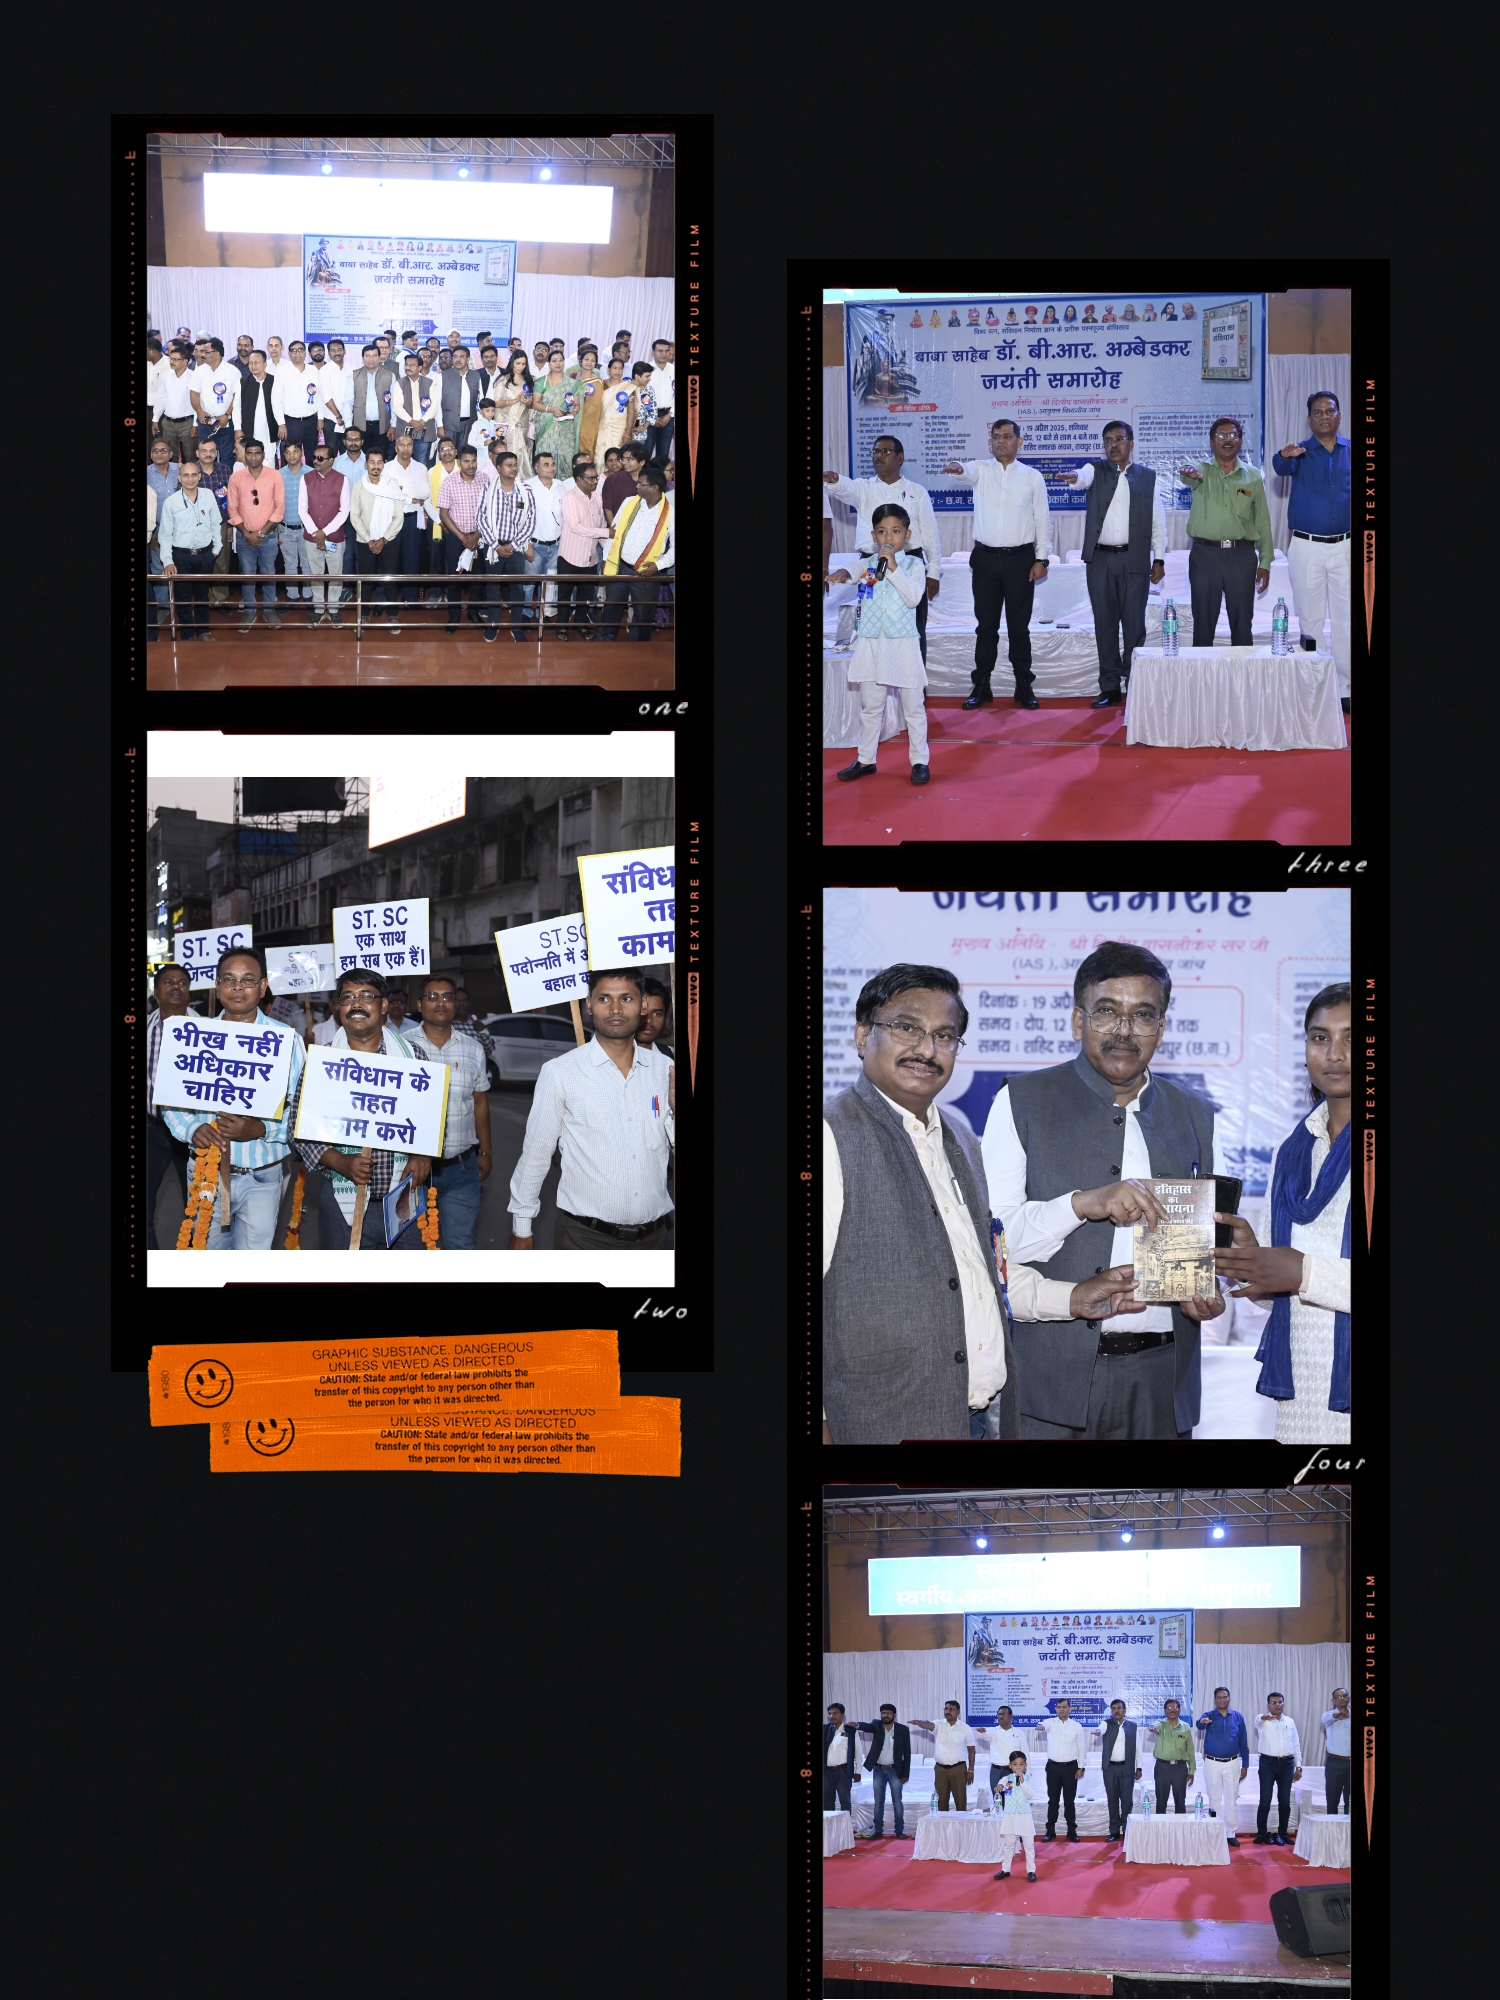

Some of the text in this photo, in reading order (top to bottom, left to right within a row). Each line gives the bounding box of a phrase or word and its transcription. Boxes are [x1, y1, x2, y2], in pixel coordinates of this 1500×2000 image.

[437, 260, 480, 272] अम्बेडकर
[374, 272, 445, 287] जयंती समारोह
[915, 336, 1192, 364] बाबा साहेब डॉ. बी.आर. अम्बेडकर
[981, 366, 1123, 390] जयंती समारोह
[945, 496, 965, 505] छ.ग.
[639, 701, 688, 715] one
[1288, 852, 1367, 873] three
[602, 861, 675, 895] संविध
[352, 906, 408, 930] ST. SC
[182, 932, 244, 959] ST. SC
[355, 930, 406, 951] एक साथ
[340, 955, 356, 972] हम
[362, 953, 380, 968] सब
[385, 952, 405, 970] एक
[510, 951, 562, 977] पदोन्नति
[564, 947, 576, 964] में
[543, 974, 577, 992] बहाल
[979, 990, 1046, 1009] दिनांक 19
[978, 1017, 1011, 1031] समय
[1054, 1019, 1066, 1032] 12
[1176, 1018, 1199, 1033] तक
[172, 1022, 284, 1057] भीख नहीं
[978, 1039, 1011, 1053] समय
[174, 1052, 274, 1082] अधिकार
[322, 1057, 431, 1093] संविधान के
[182, 1077, 256, 1110] चाहिए
[350, 1090, 398, 1115] तहत
[375, 1117, 416, 1145] करो
[1154, 1183, 1192, 1196] इतिहास
[1168, 1196, 1179, 1204] का
[633, 1298, 688, 1319] two
[1293, 1448, 1366, 1484] four
[1106, 1633, 1153, 1645] अम्बेडकर
[1038, 1649, 1116, 1662] जयंती समारोह
